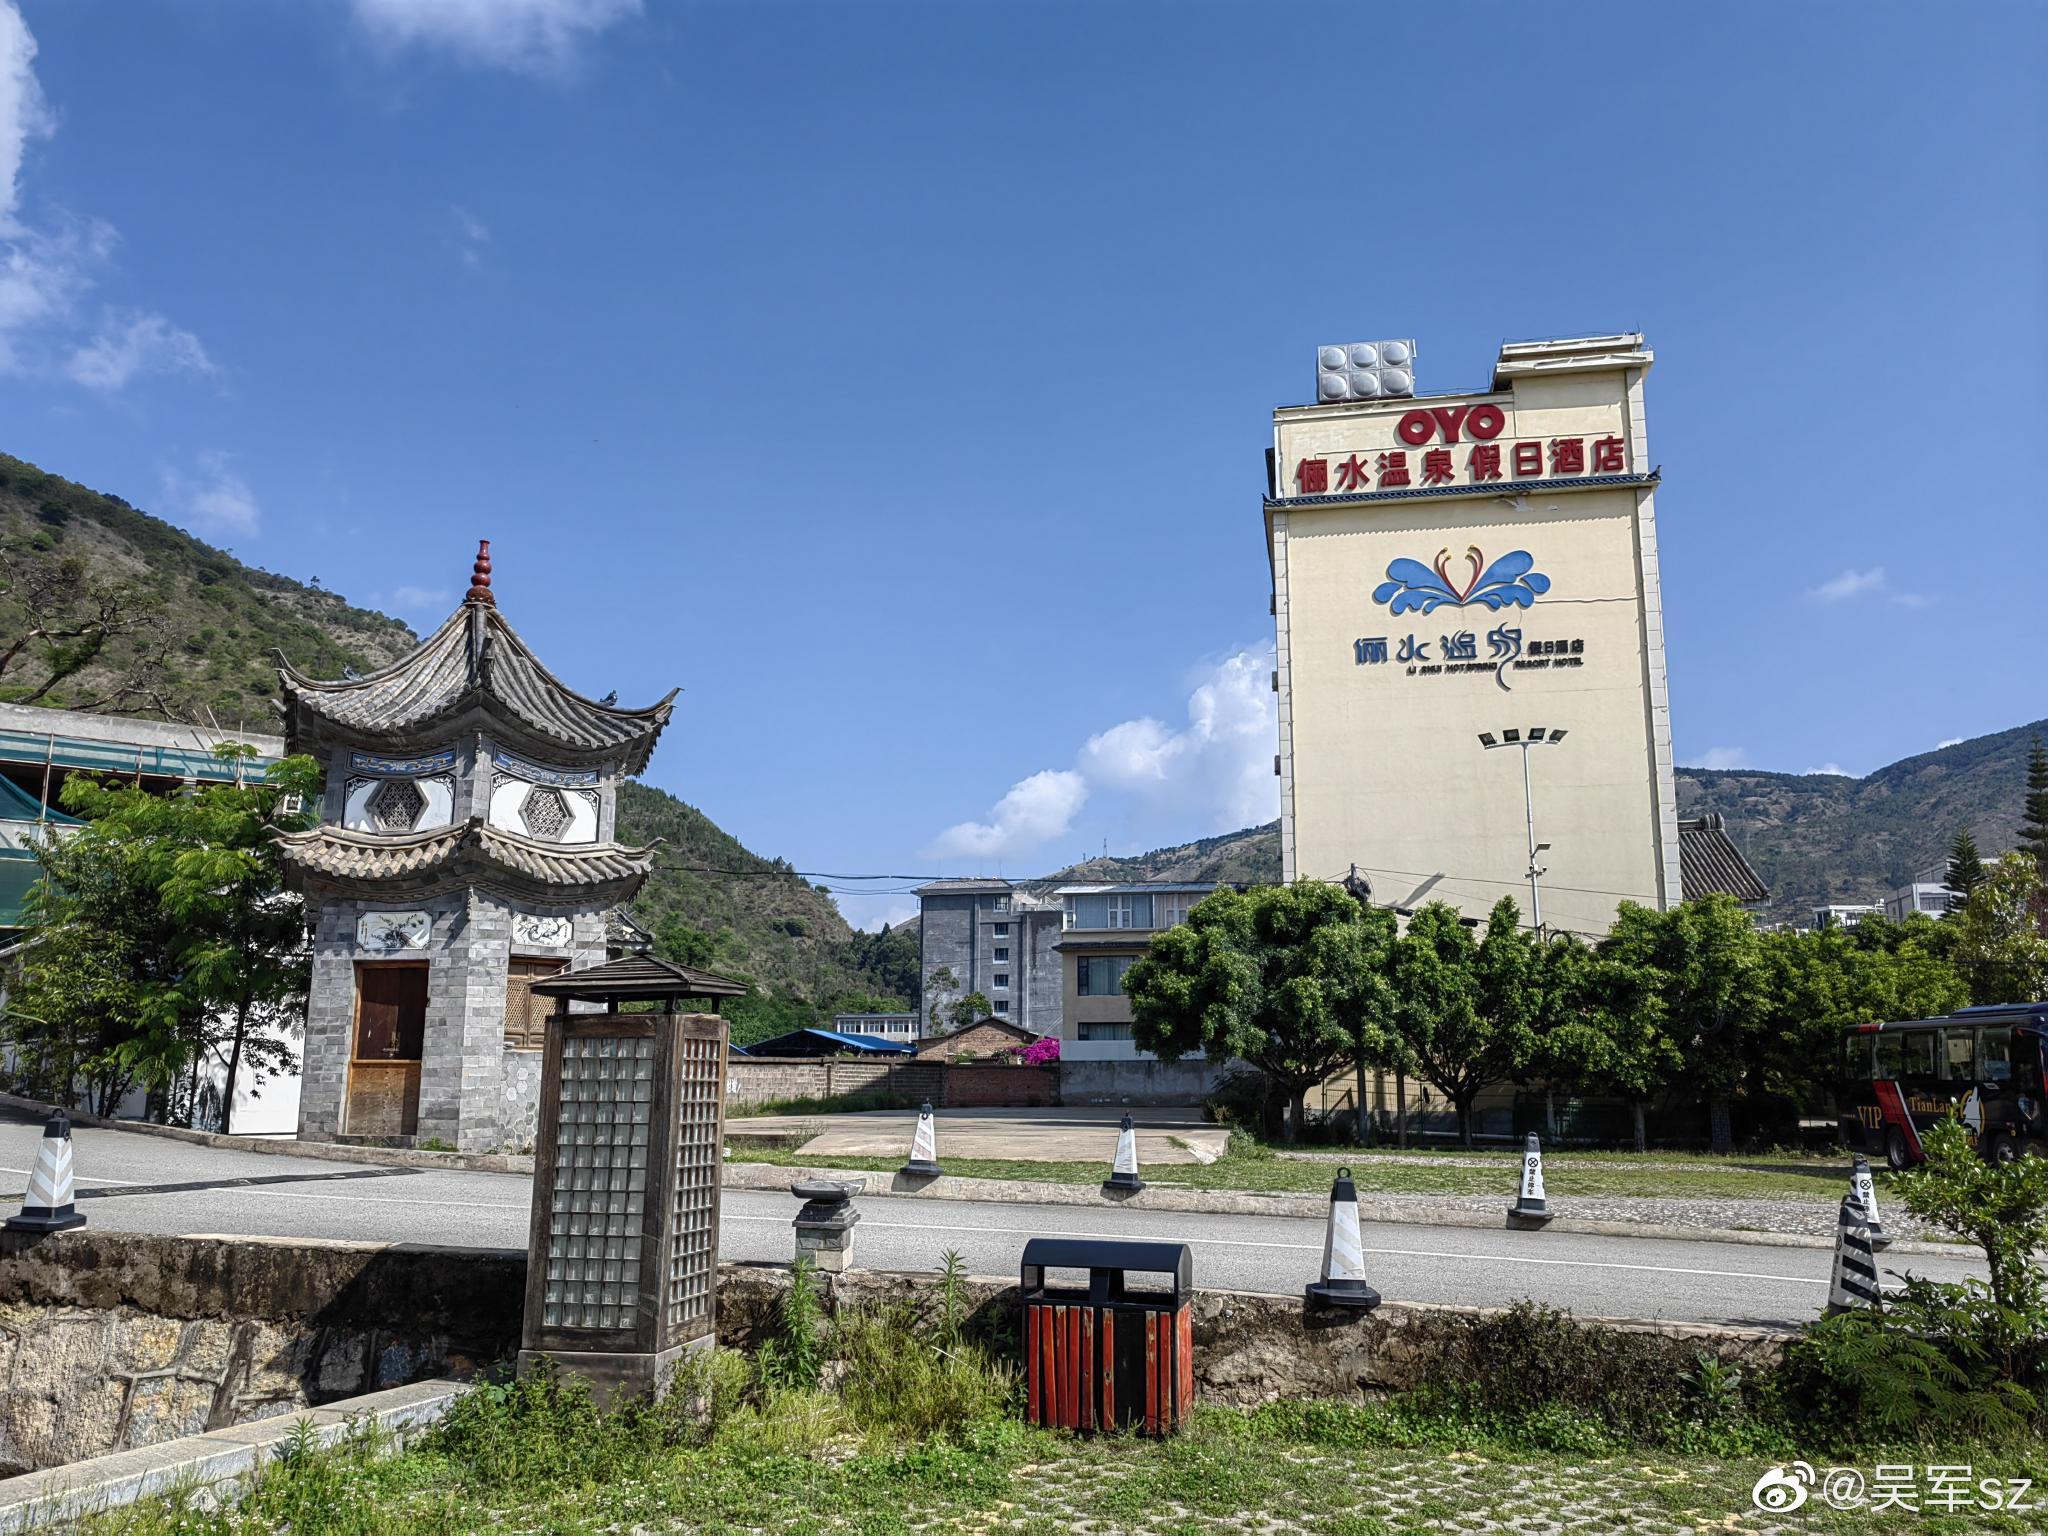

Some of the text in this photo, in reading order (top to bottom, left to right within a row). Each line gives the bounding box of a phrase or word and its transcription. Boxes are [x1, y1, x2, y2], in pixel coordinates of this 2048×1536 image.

[1397, 404, 1506, 446] OYO
[1297, 435, 1625, 493] 俪水温泉假日酒店
[1553, 657, 1584, 668] HOTEL
[1909, 1096, 1951, 1113] TianLan
[1856, 1105, 1882, 1129] VIP
